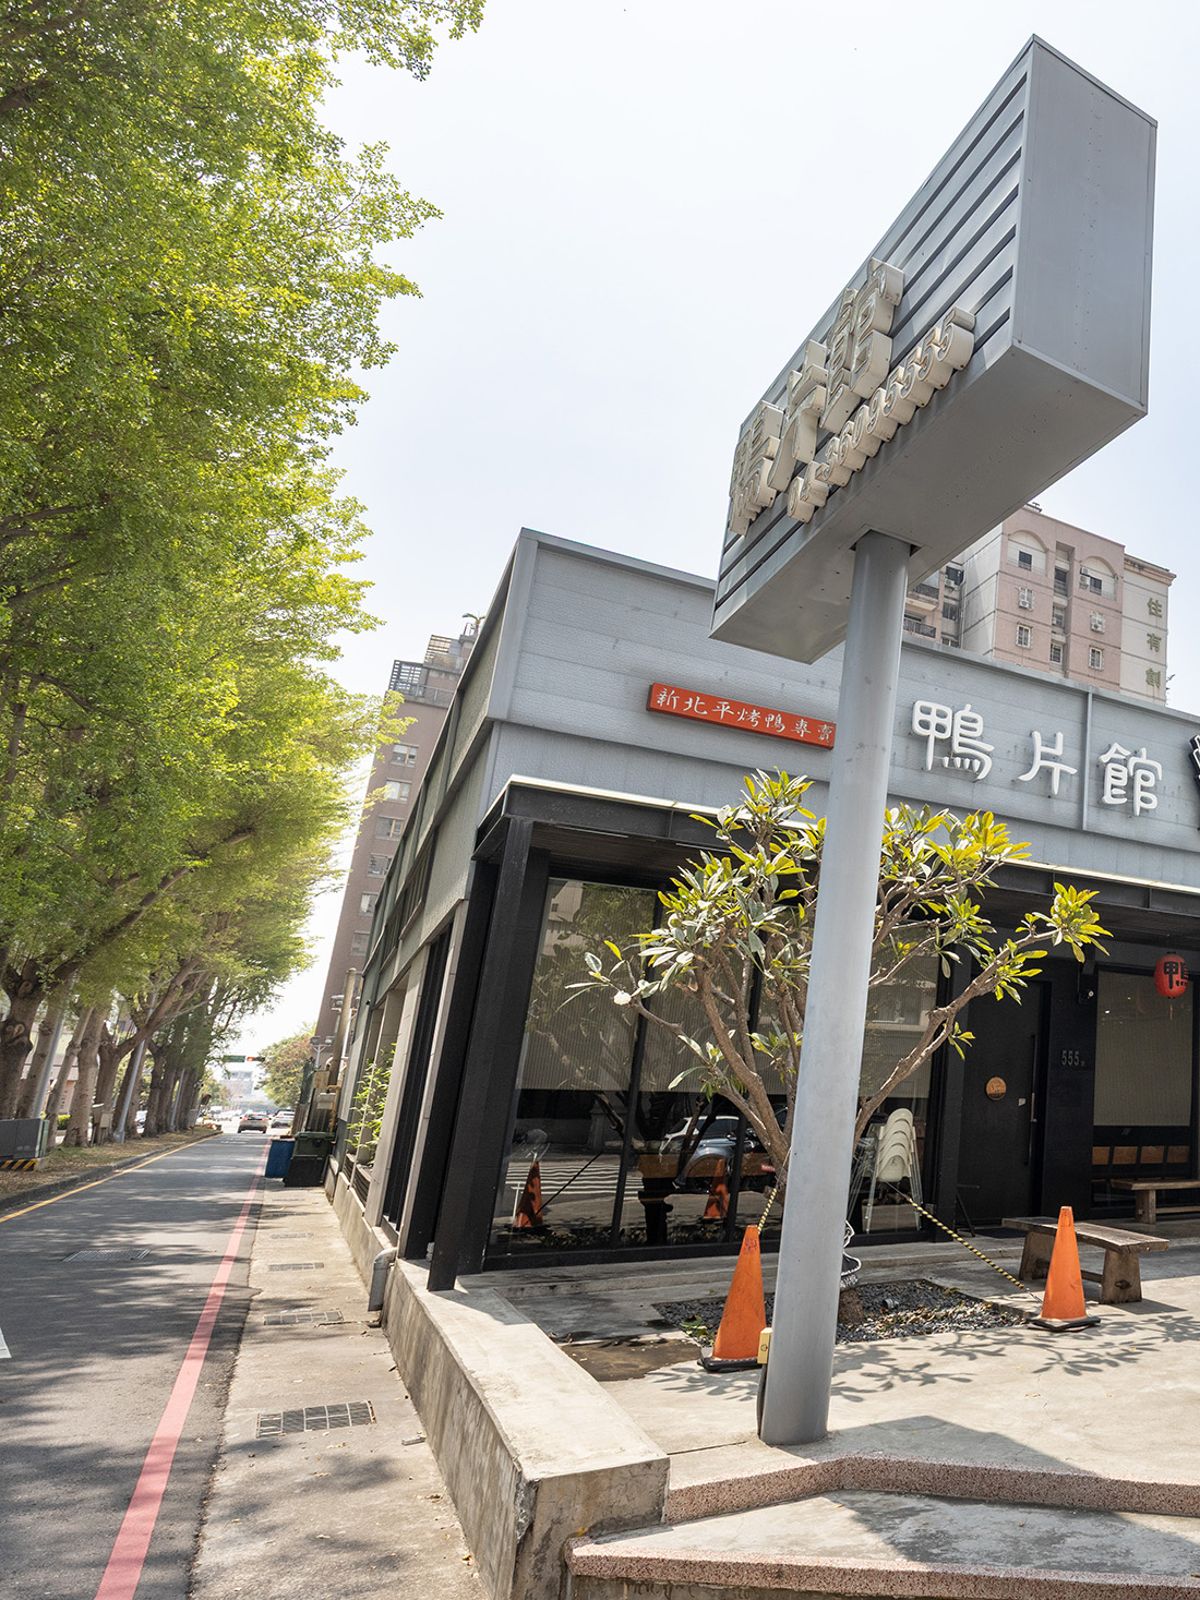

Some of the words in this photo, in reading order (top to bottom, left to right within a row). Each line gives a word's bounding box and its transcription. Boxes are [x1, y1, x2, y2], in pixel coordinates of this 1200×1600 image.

[656, 687, 833, 744] 新北平烤鴨專賣
[910, 699, 1163, 817] 鴨片館
[1061, 1050, 1085, 1067] 555
